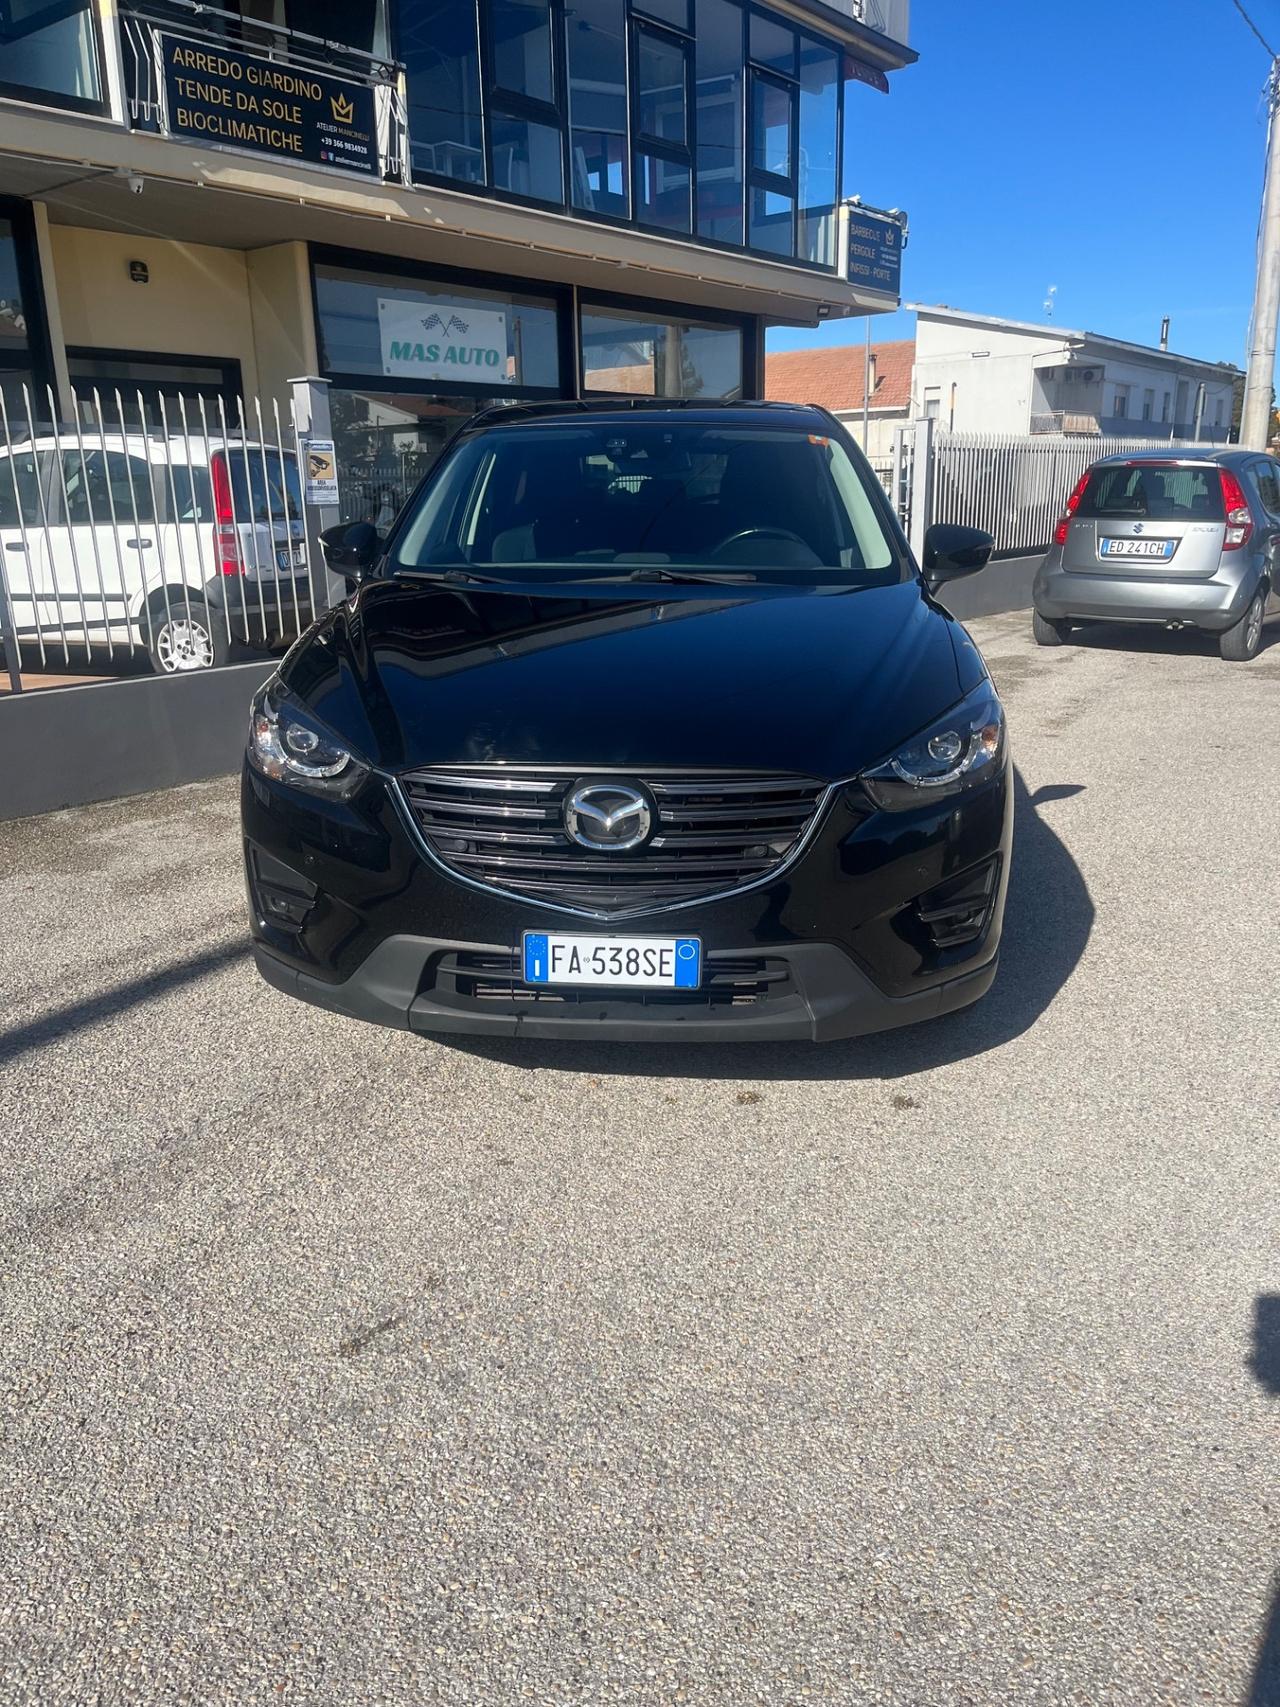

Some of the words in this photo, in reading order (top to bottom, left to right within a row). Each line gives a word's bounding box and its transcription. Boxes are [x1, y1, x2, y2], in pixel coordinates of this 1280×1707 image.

[173, 47, 243, 81] ARREDO
[246, 66, 323, 101] GIARDINO
[174, 76, 233, 107] TENDE
[236, 92, 259, 114] DA
[262, 99, 303, 125] SOLE
[177, 108, 303, 153] BIOCLIMATICHE
[316, 121, 338, 134] ATELIER
[321, 137, 333, 146] +39
[333, 139, 344, 149] 366
[389, 341, 441, 362] MAS
[443, 345, 500, 367] AUTO
[1109, 541, 1124, 553] ED
[1127, 542, 1165, 555] 241CH
[592, 947, 674, 978] 538SE
